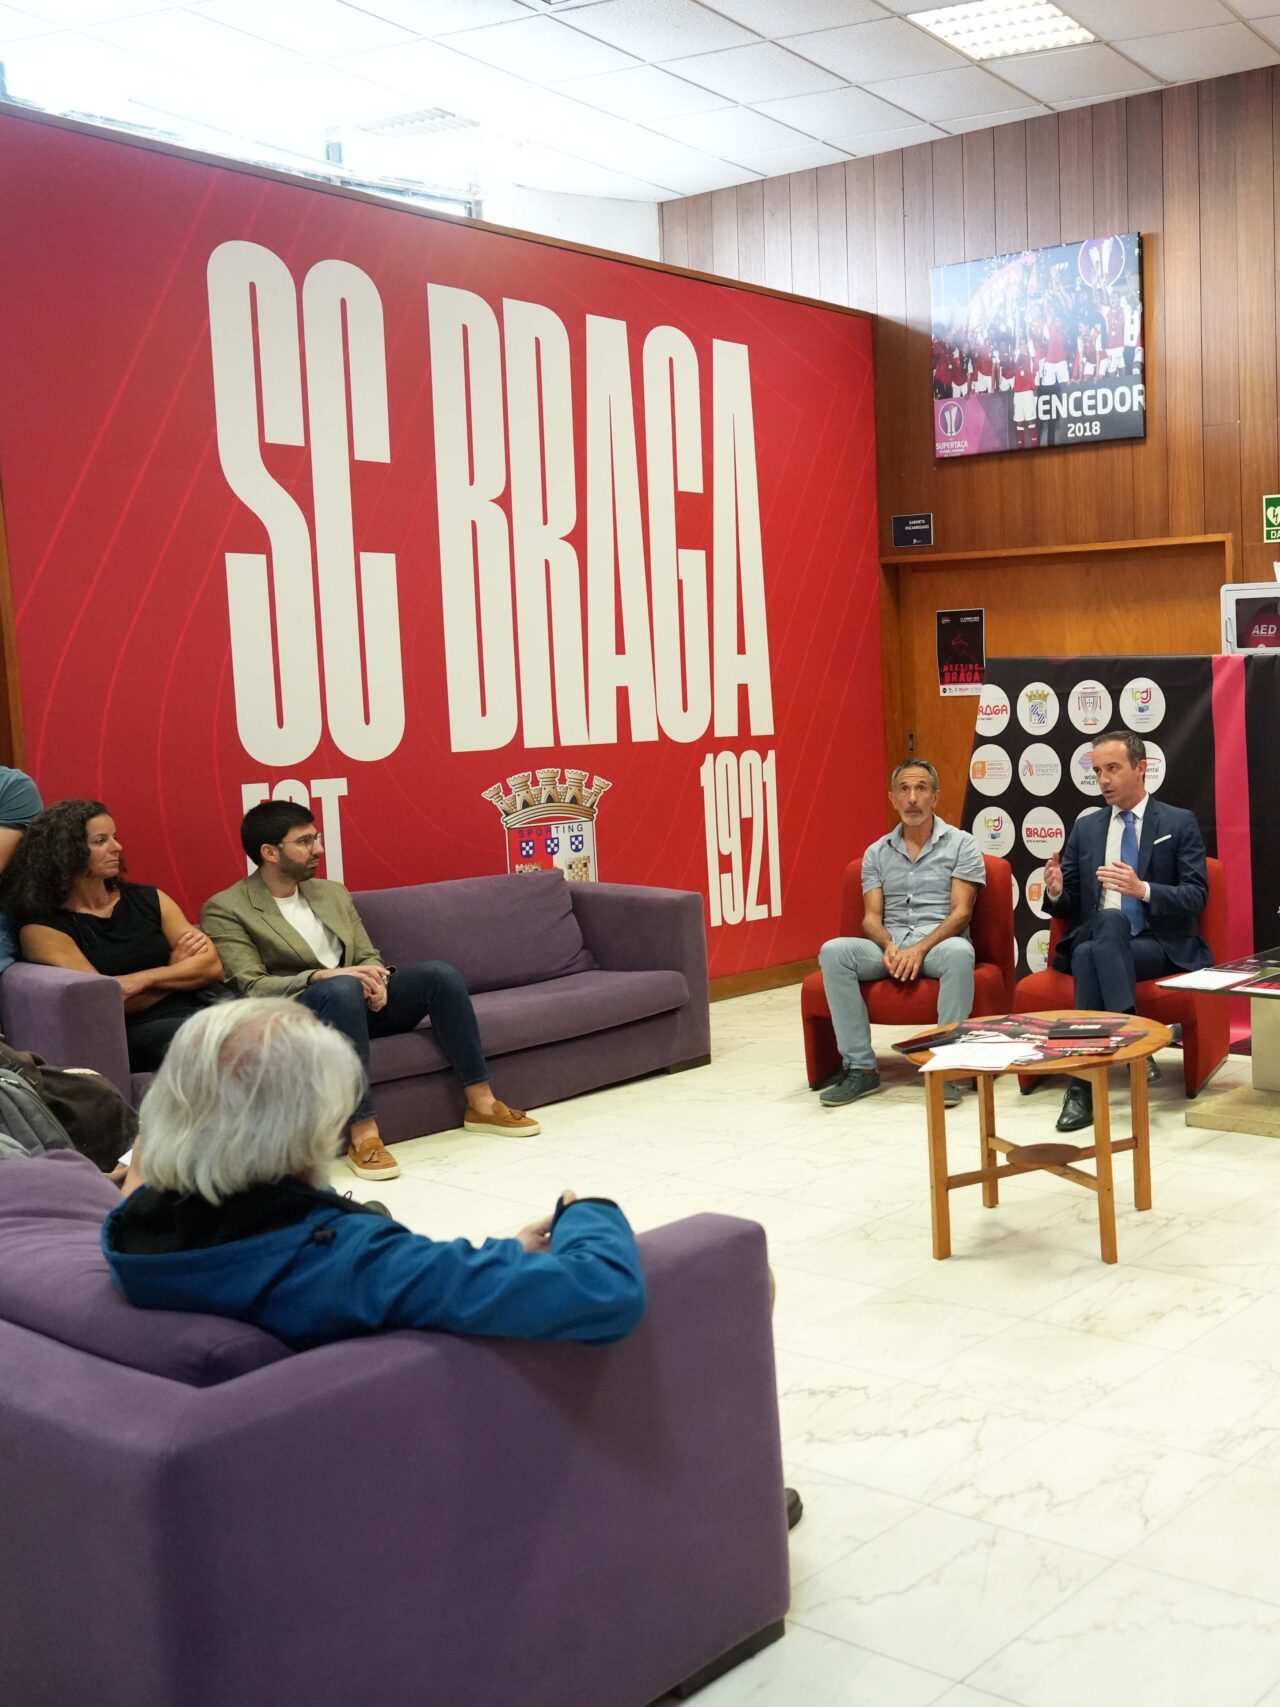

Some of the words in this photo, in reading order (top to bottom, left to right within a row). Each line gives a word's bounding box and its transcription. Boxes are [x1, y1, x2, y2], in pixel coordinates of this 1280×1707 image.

[1035, 384, 1146, 422] ENCEDOR
[1066, 421, 1101, 438] 2018
[206, 240, 406, 767] SC
[427, 282, 775, 754] BRAGA
[1252, 624, 1277, 635] AED
[944, 671, 981, 683] BRAGA
[978, 704, 1008, 716] RAGA
[517, 823, 584, 838] SPORTING
[1026, 827, 1063, 839] BRAGA
[699, 750, 783, 927] 1921
